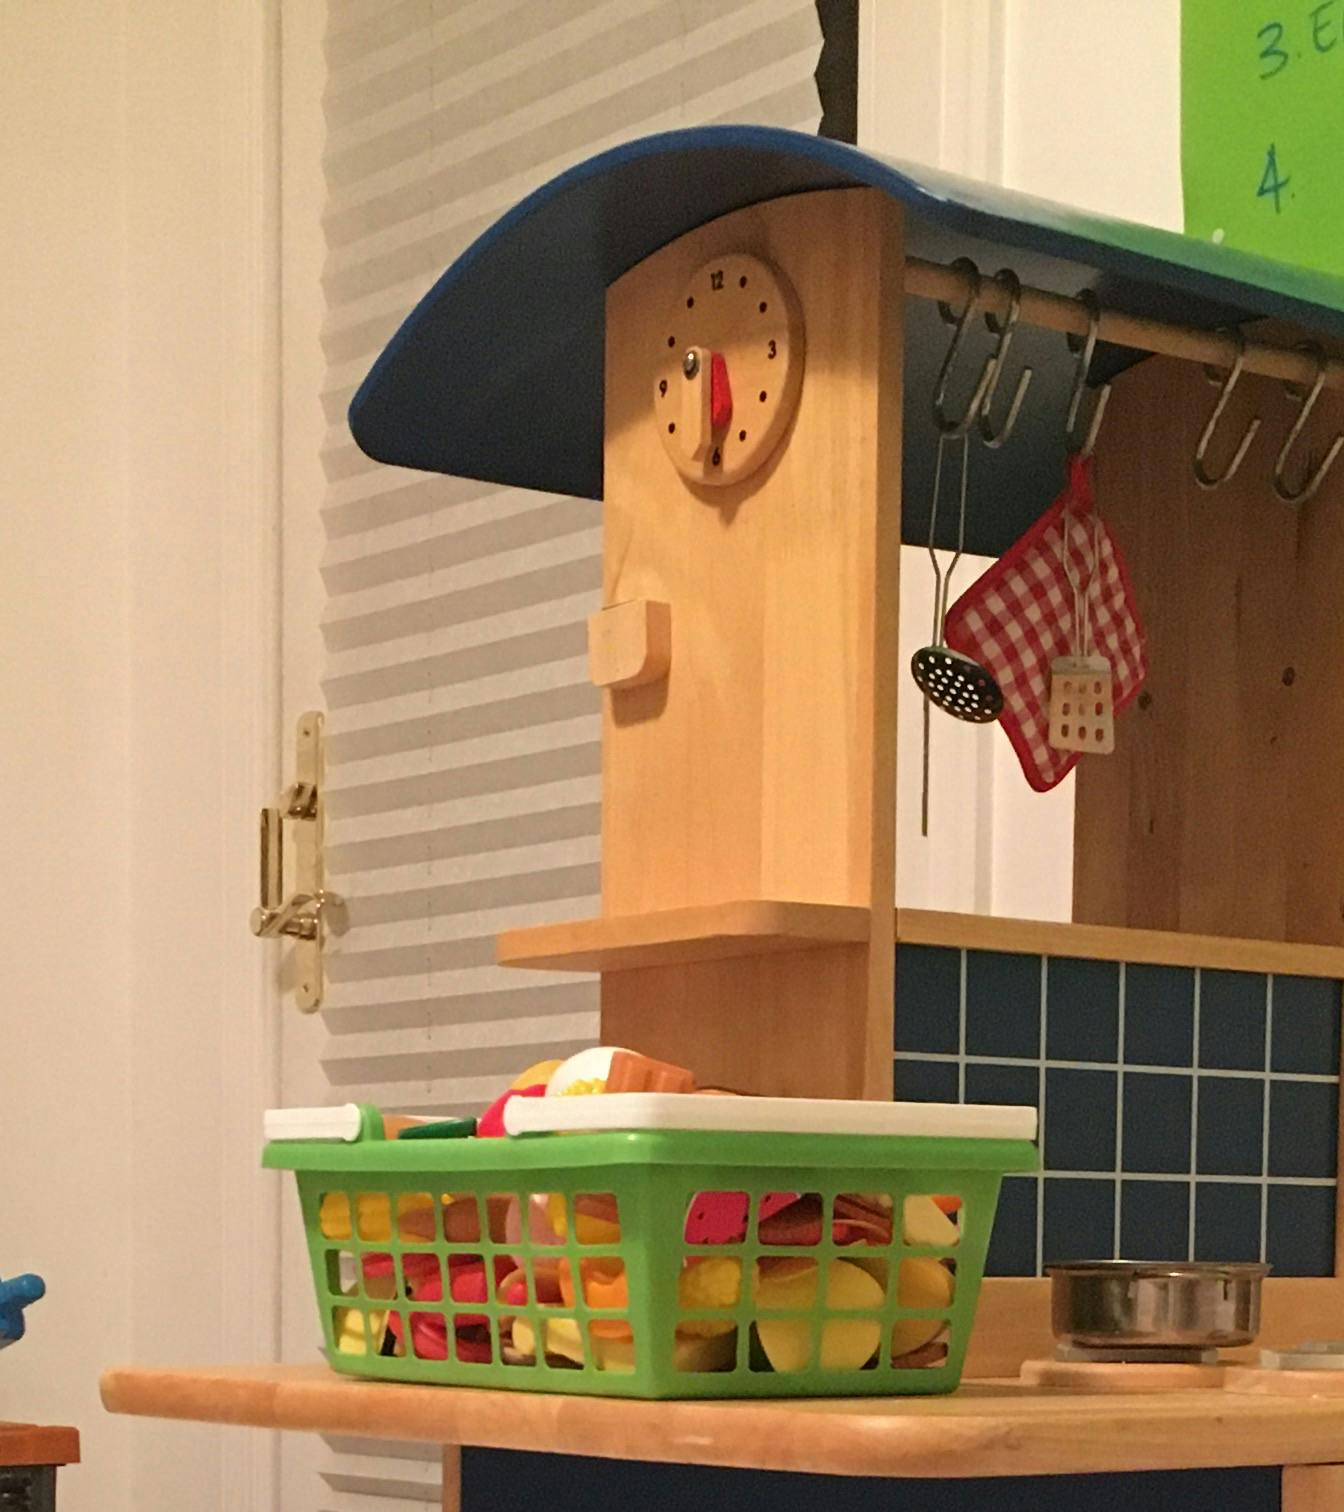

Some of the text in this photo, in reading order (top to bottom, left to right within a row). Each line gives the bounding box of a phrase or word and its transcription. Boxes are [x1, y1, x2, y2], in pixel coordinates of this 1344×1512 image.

[711, 270, 724, 290] 12
[768, 340, 776, 359] 3
[659, 379, 668, 397] 9
[712, 447, 720, 466] 6
